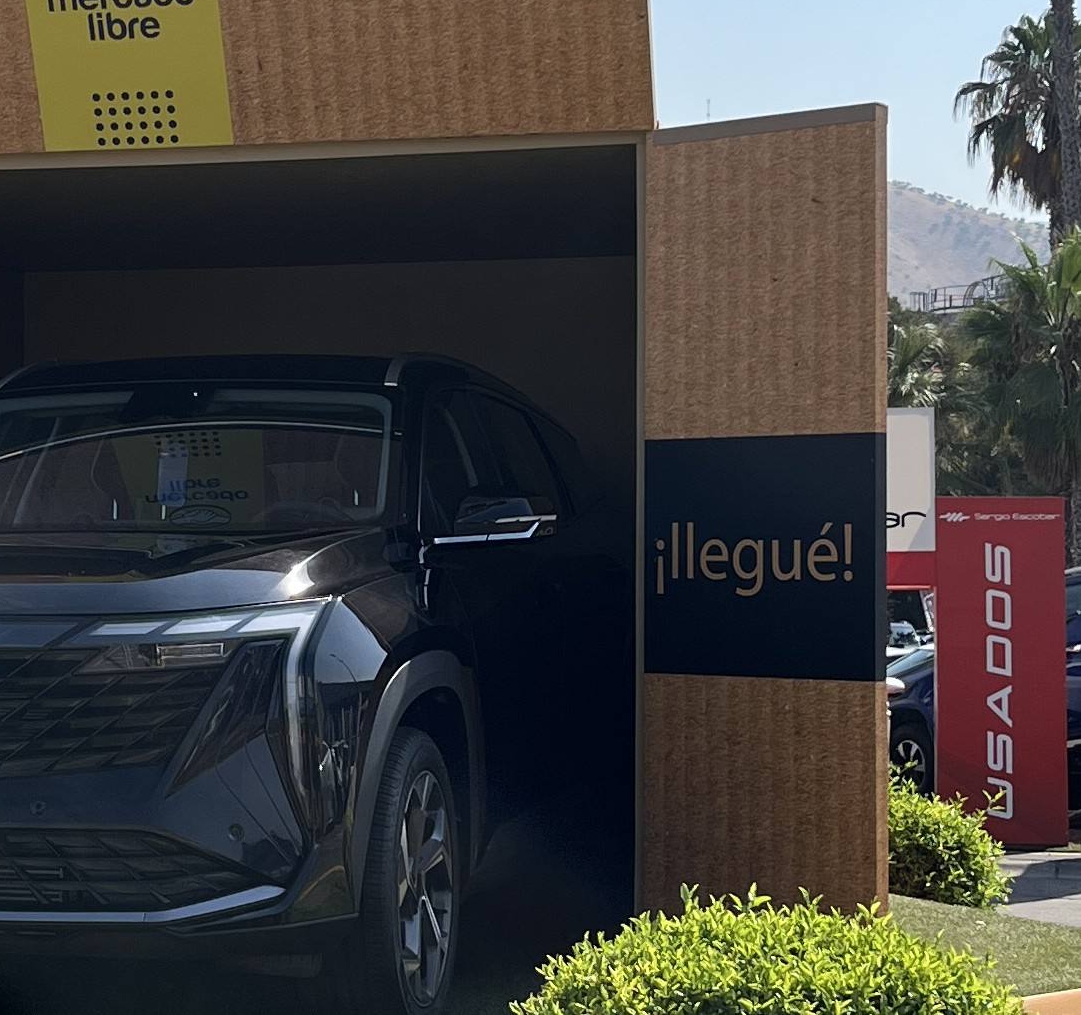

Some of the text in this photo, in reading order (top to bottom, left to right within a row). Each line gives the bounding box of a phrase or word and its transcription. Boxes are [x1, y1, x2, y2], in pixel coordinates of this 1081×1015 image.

[87, 12, 160, 41] libre
[974, 512, 1011, 522] Sergo
[655, 522, 854, 597] ¡llegué!
[985, 542, 1014, 820] USADOS
